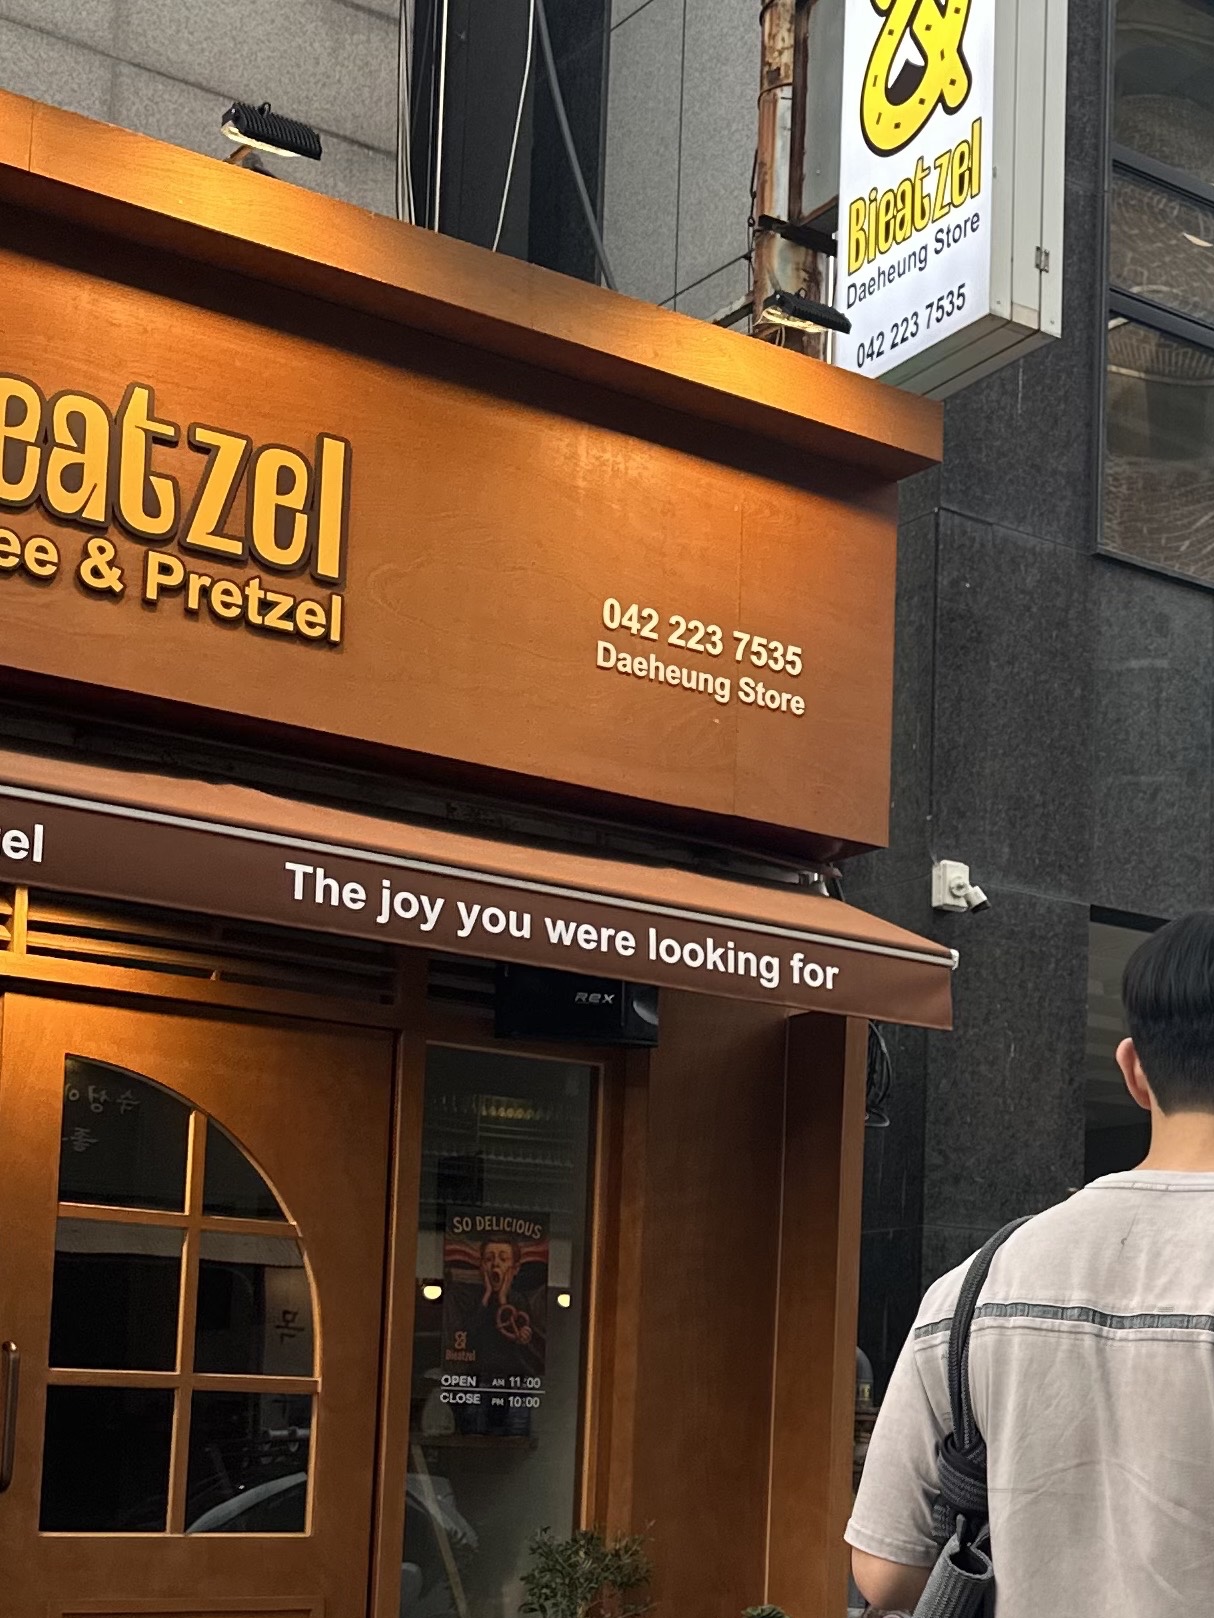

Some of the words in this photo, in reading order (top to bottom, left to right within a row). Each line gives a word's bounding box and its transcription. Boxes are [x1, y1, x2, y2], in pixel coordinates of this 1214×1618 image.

[847, 116, 982, 278] Bieatzel
[846, 243, 928, 310] Daeheung
[934, 211, 981, 256] Store
[857, 331, 885, 368] 042
[889, 311, 920, 350] 223
[925, 283, 967, 330] 7535
[0, 374, 349, 582] eatzel
[79, 537, 125, 593] &
[145, 550, 342, 643] Pretzel
[596, 640, 731, 704] Daeheung
[738, 676, 805, 716] Store
[603, 597, 659, 641] 042
[668, 614, 723, 657] 223
[732, 630, 803, 677] 7535
[0, 823, 44, 863] el
[285, 862, 367, 911] The
[376, 879, 445, 932] joy
[457, 901, 531, 939] you
[544, 917, 636, 957] were
[649, 928, 780, 989] looking
[790, 952, 839, 990] for
[453, 1216, 472, 1233] SO
[476, 1216, 542, 1239] DELICIOUS
[440, 1392, 481, 1405] CLOSE
[491, 1398, 504, 1406] PM
[508, 1396, 540, 1408] 10:00
[441, 1375, 477, 1387] OPEN
[492, 1378, 505, 1387] AM
